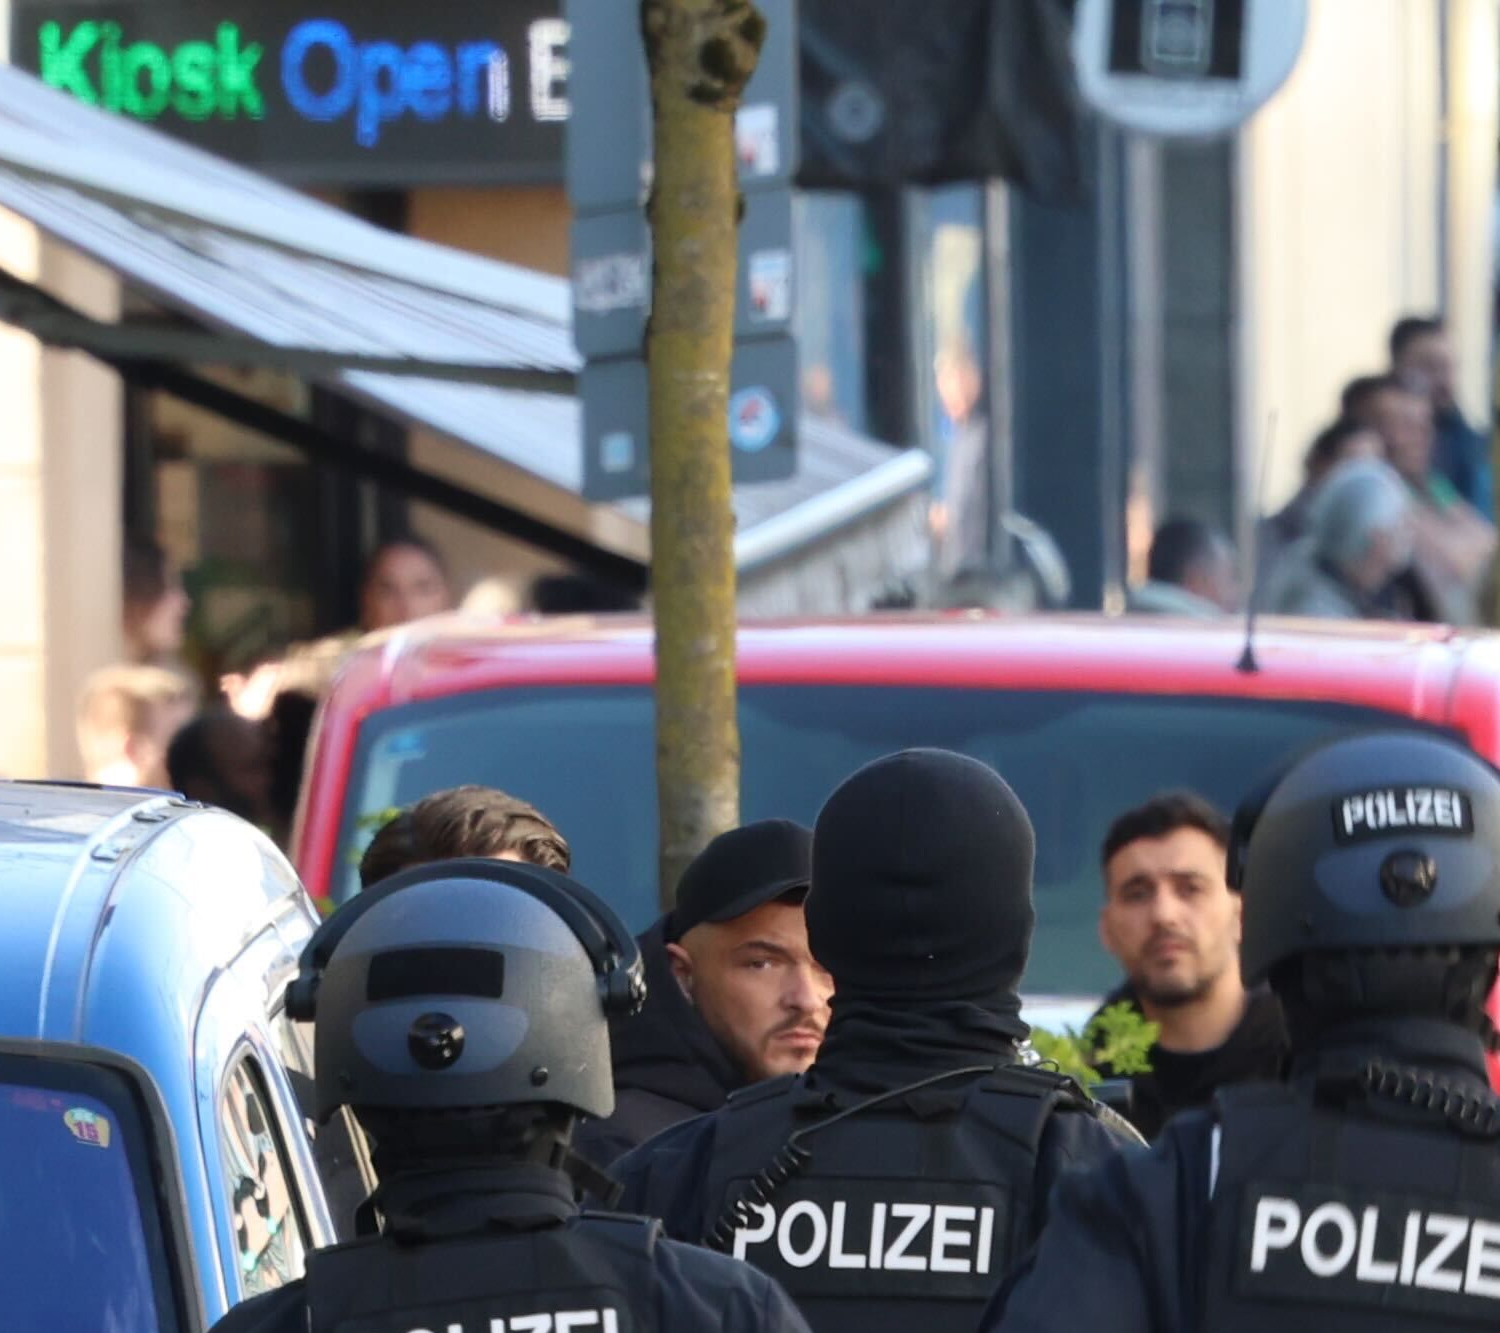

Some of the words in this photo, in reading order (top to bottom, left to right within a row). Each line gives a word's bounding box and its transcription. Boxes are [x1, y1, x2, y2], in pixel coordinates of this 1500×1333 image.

[38, 18, 265, 122] Kiosk
[281, 17, 510, 149] Open
[1342, 787, 1463, 834] POLIZEI
[732, 1199, 995, 1274] POLIZEI
